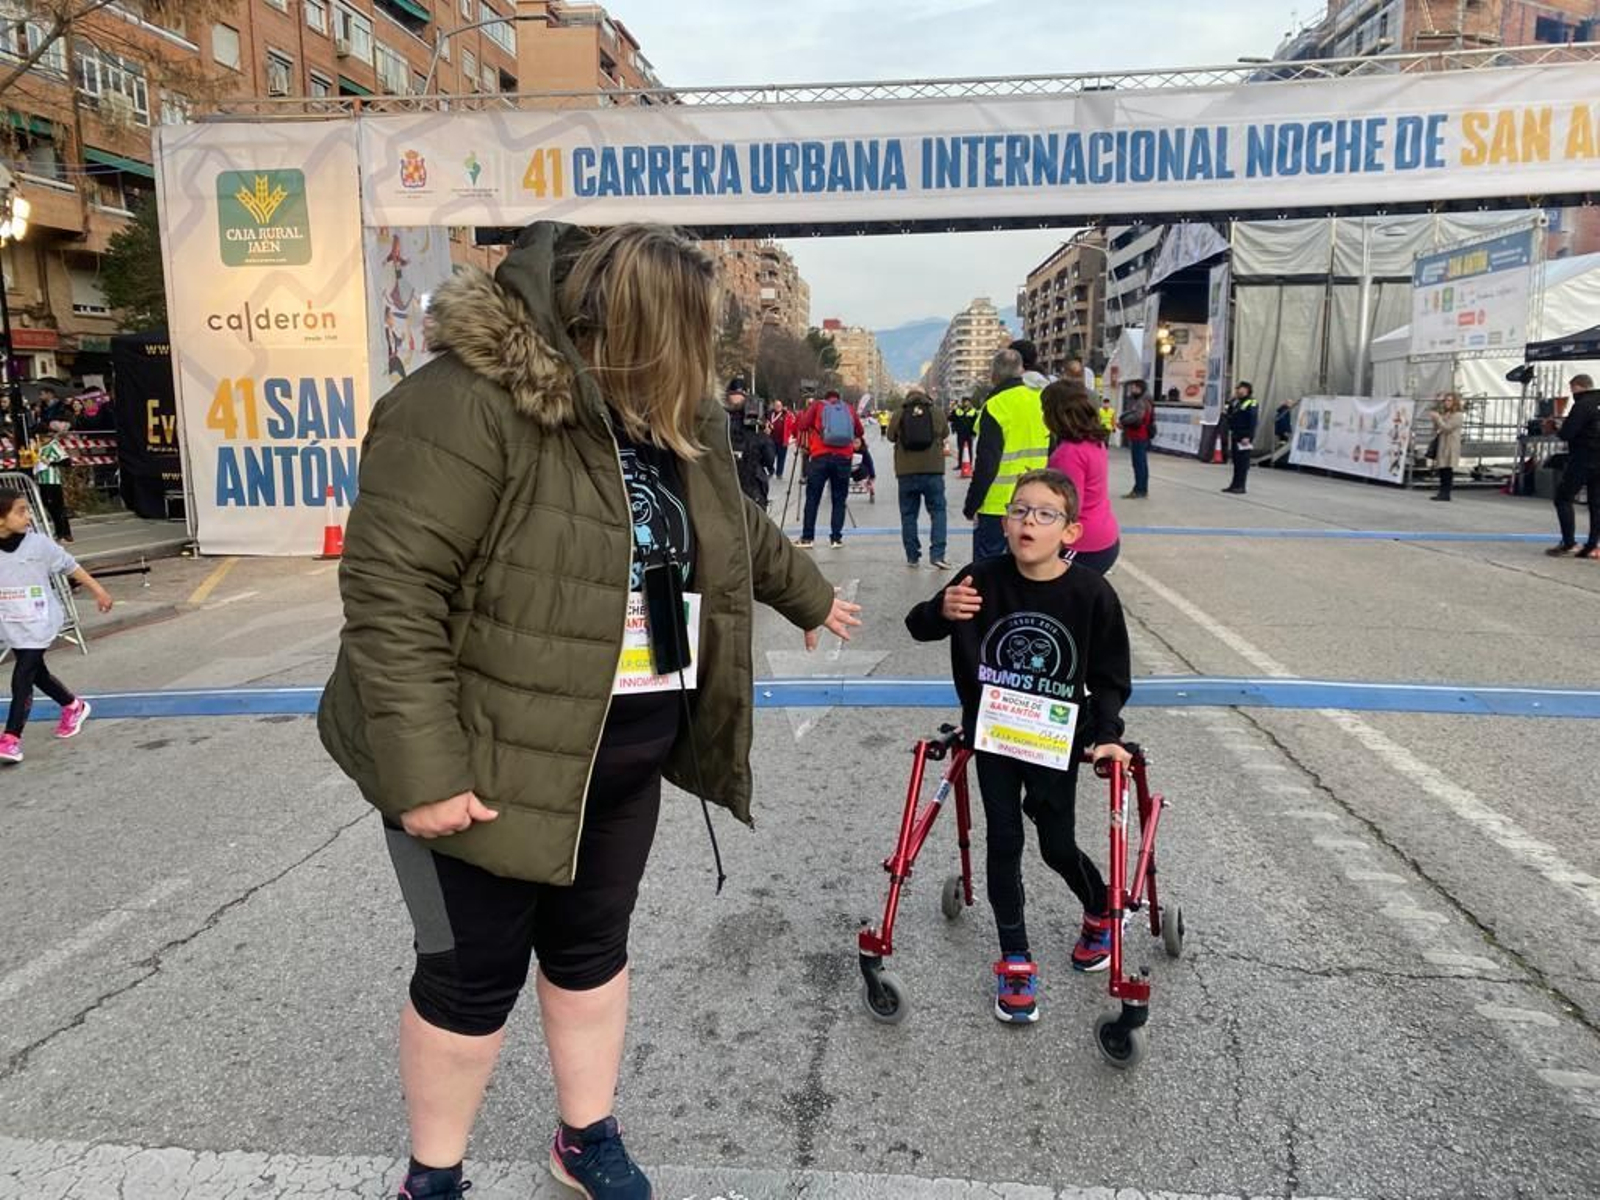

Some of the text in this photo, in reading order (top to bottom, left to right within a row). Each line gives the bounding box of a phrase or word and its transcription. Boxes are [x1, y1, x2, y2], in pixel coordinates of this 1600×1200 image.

[522, 103, 1600, 198] 41 CARRERA URBANA INTERNACIONAL NOCHE DE SAN A
[226, 226, 304, 241] CAJA RURAL
[206, 377, 356, 439] 41 SAN
[216, 440, 358, 506] ANTÓN
[978, 665, 1034, 690] BRUNO'S
[1037, 677, 1076, 698] FLOW
